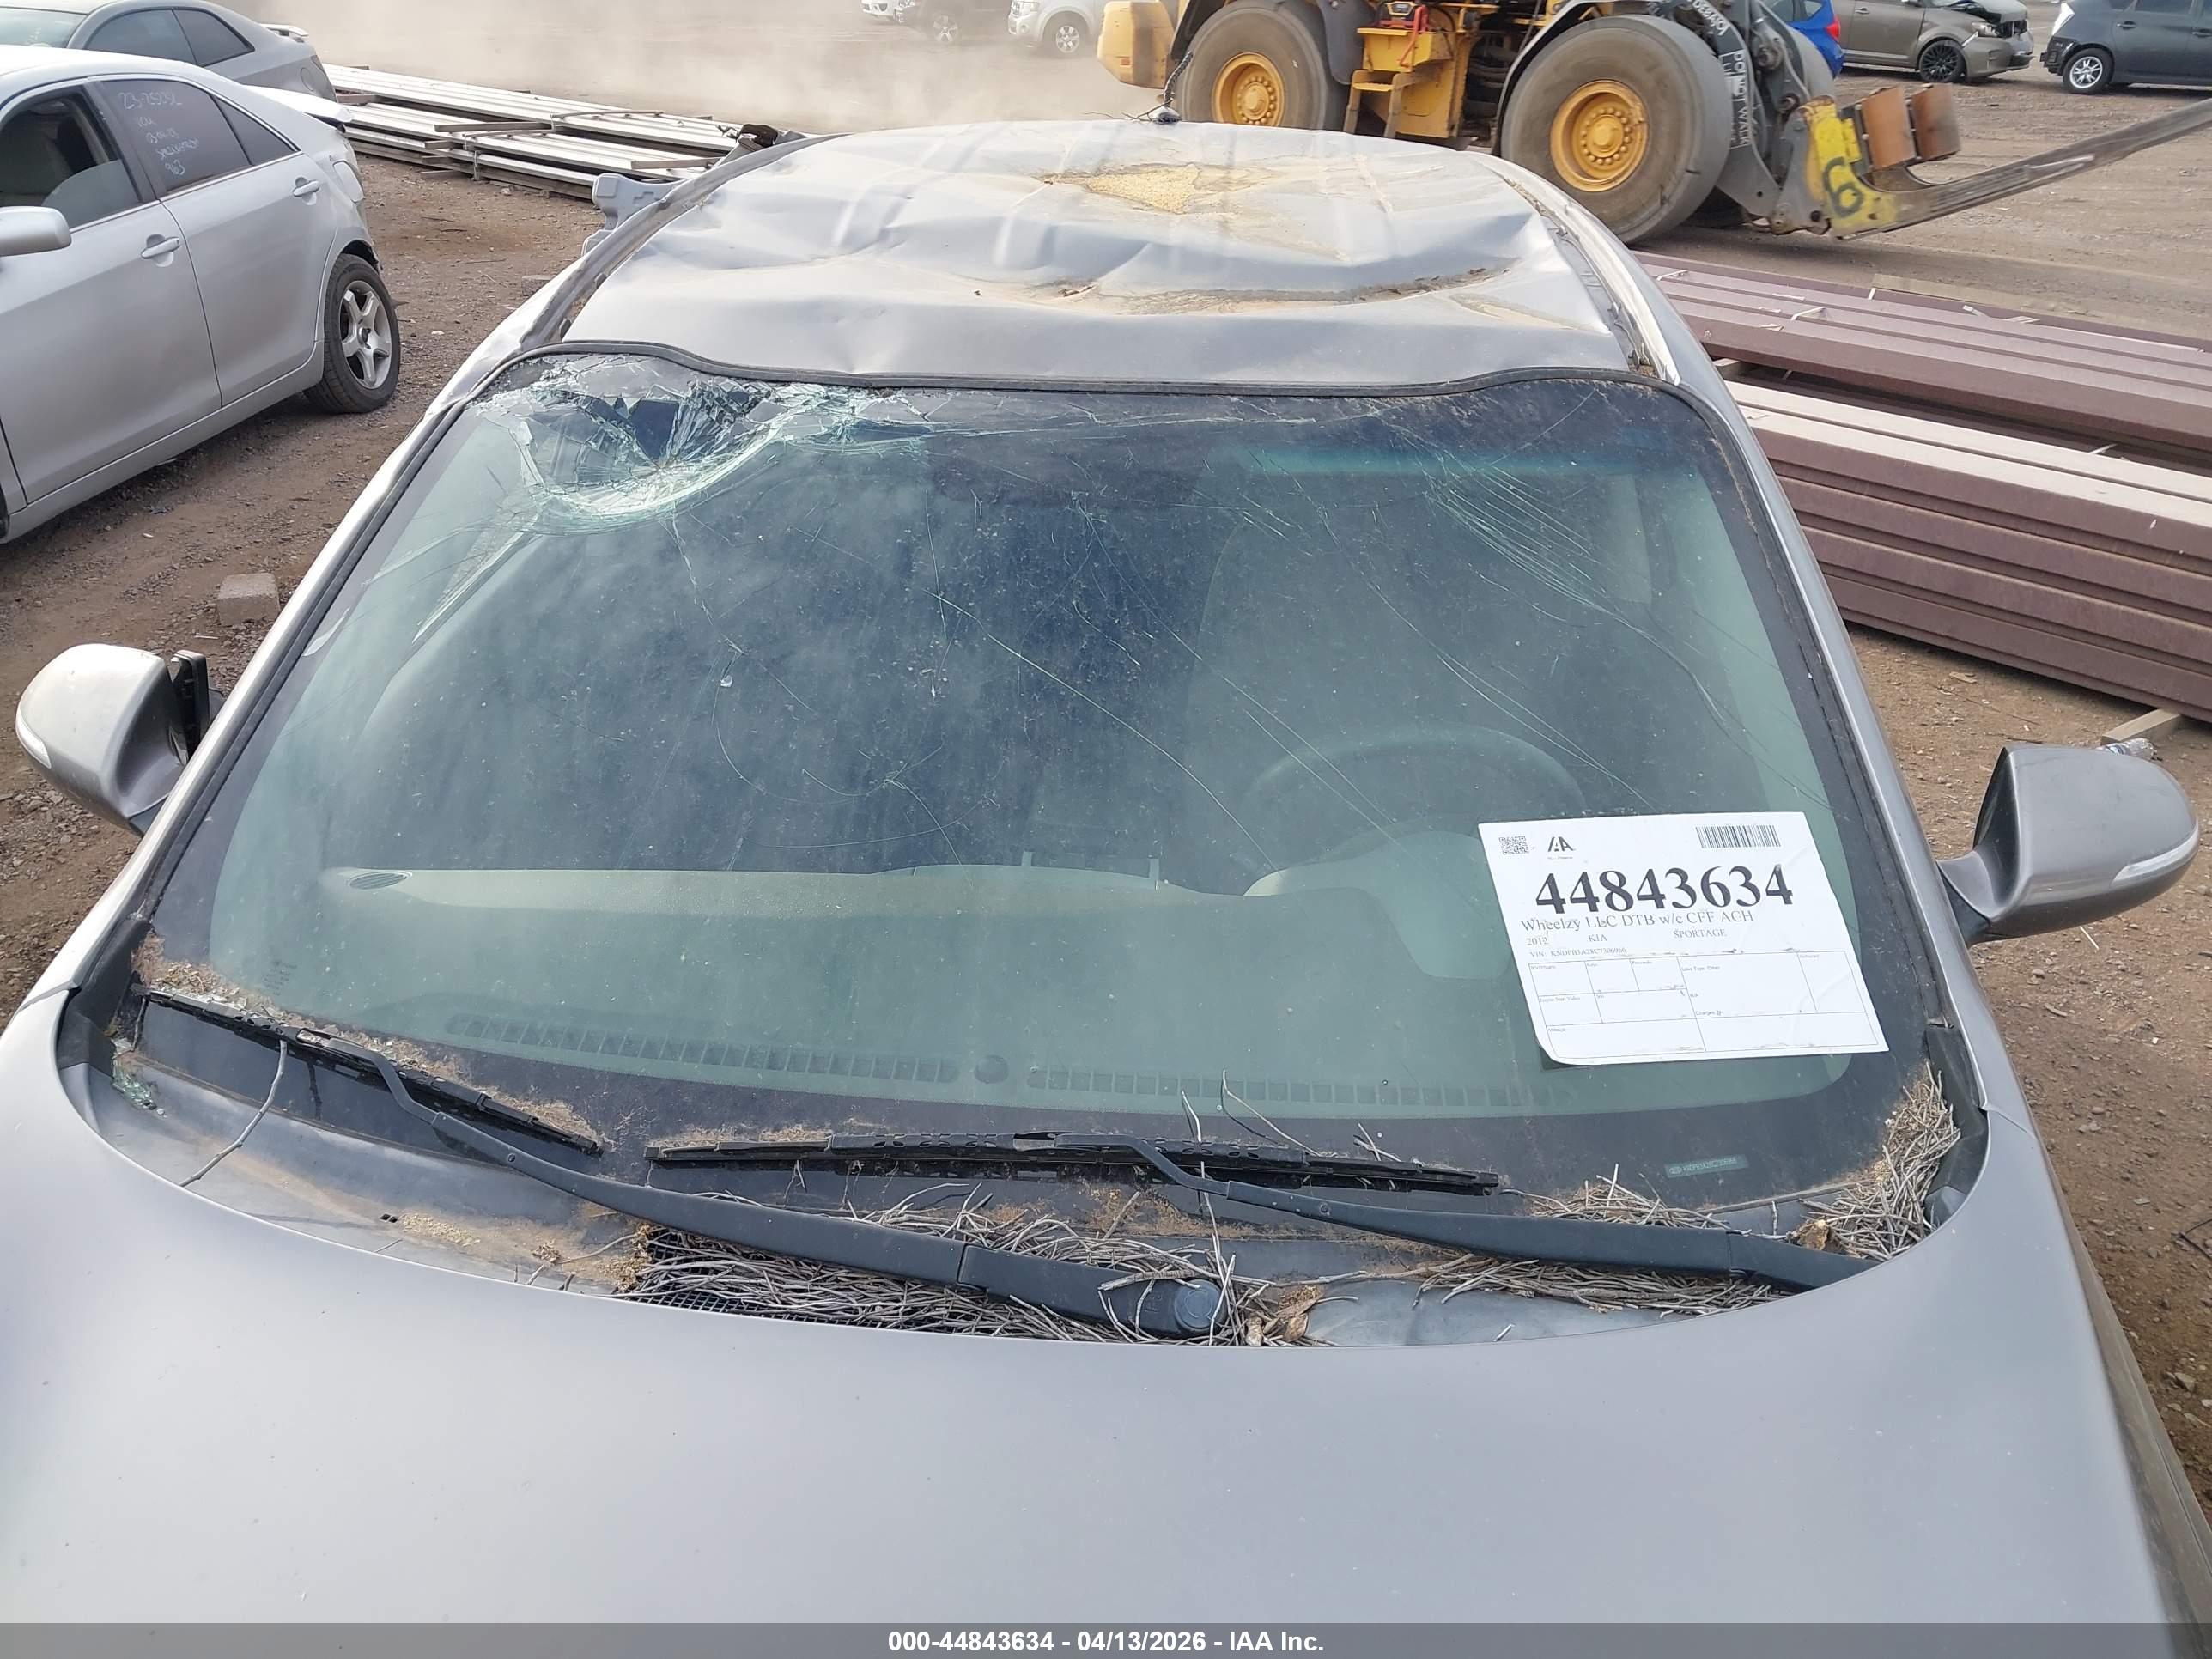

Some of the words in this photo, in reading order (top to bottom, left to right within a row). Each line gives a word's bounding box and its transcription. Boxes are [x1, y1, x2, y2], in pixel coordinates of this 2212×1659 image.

[1822, 156, 1865, 220] 6
[1535, 864, 1793, 914] 44843634
[1520, 917, 1581, 932] Wheelzy
[1585, 915, 1618, 928] LLC
[1621, 914, 1656, 927] DTB
[1659, 912, 1684, 925] w/c
[1686, 910, 1714, 924] CFF
[1720, 909, 1754, 923] ACH
[1526, 936, 1549, 946] 2012
[1588, 933, 1608, 943] KIA
[1673, 927, 1727, 939] SPORTAGE
